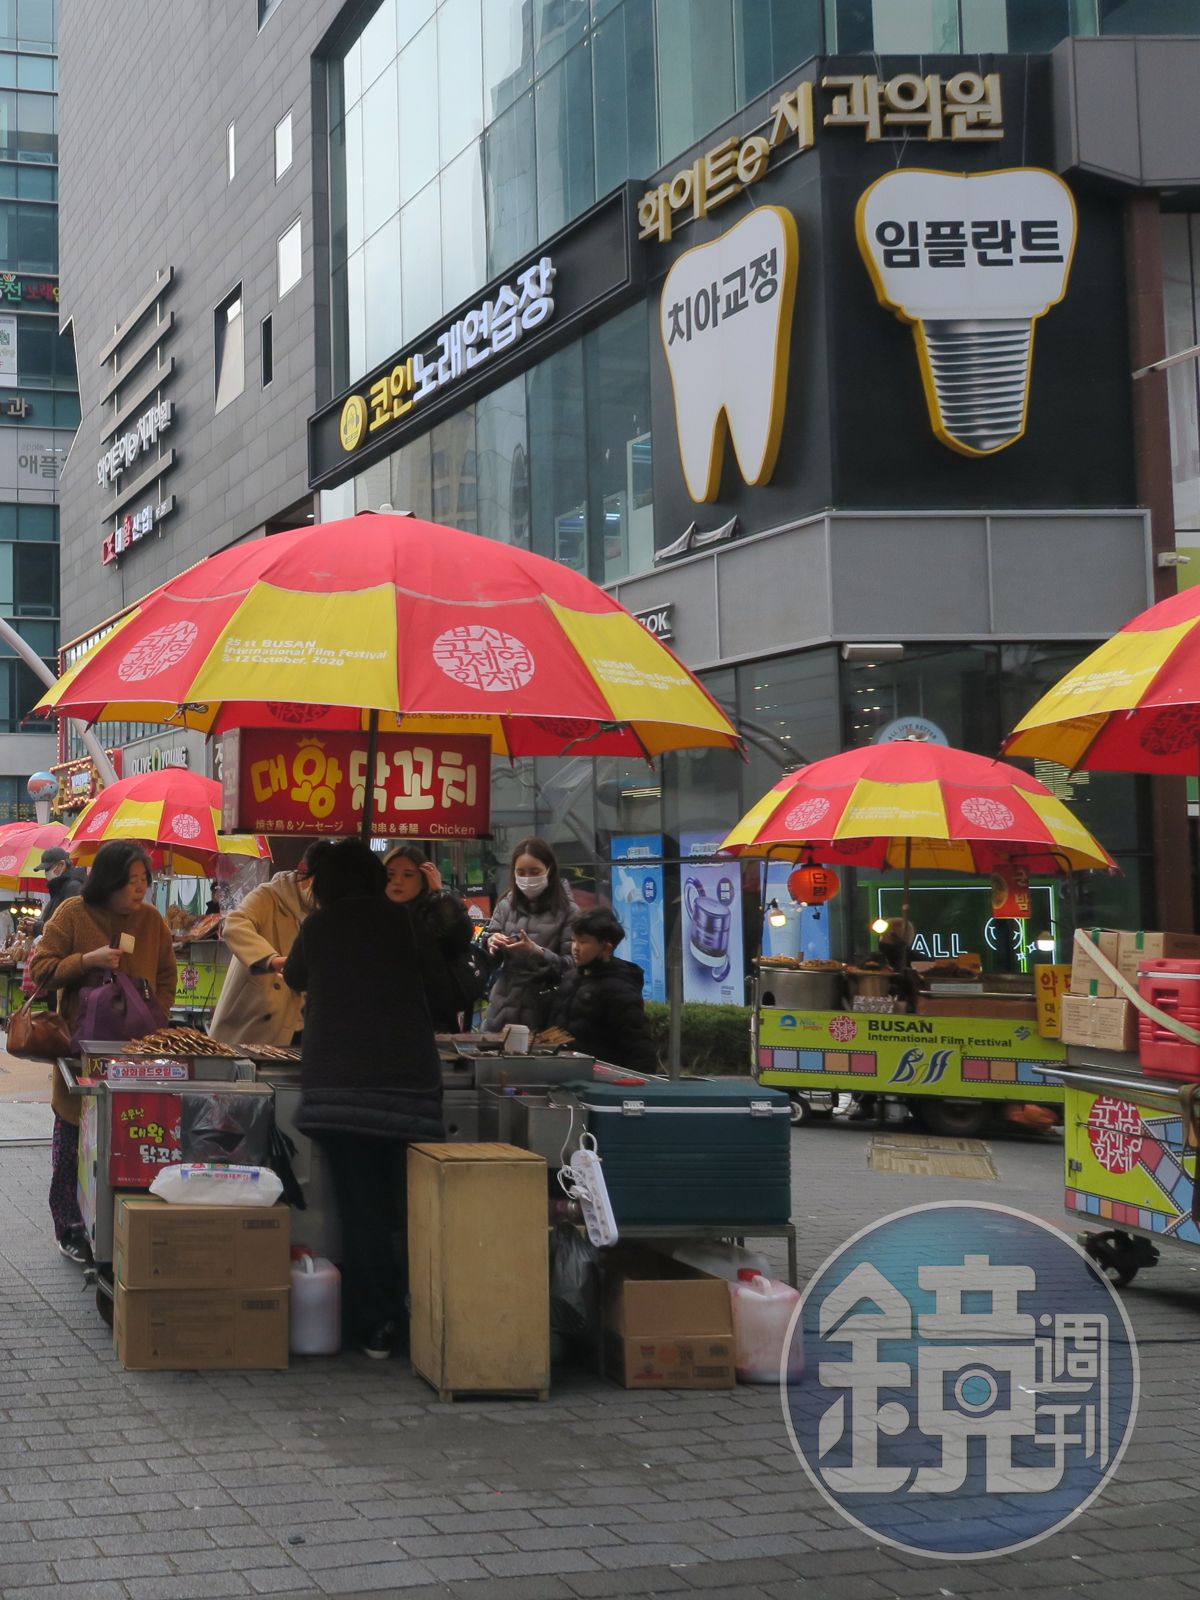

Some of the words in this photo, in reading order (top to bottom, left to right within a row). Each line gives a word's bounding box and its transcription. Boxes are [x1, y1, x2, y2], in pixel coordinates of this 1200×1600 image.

[875, 220, 1064, 268] 임플란트
[667, 248, 778, 346] 치아교정
[262, 639, 317, 649] BUSAN
[224, 646, 305, 656] International
[307, 647, 336, 657] Film
[338, 649, 388, 660] Festival
[311, 656, 345, 666] 2020
[161, 746, 187, 768] YOUNG
[429, 823, 476, 835] Chicken
[370, 838, 387, 851] UNG
[911, 933, 968, 958] ALL
[868, 1020, 933, 1034] BUSAN
[868, 1034, 938, 1045] International
[940, 1036, 965, 1046] Film
[967, 1037, 1012, 1047] Festival
[129, 1123, 165, 1144] 대왕
